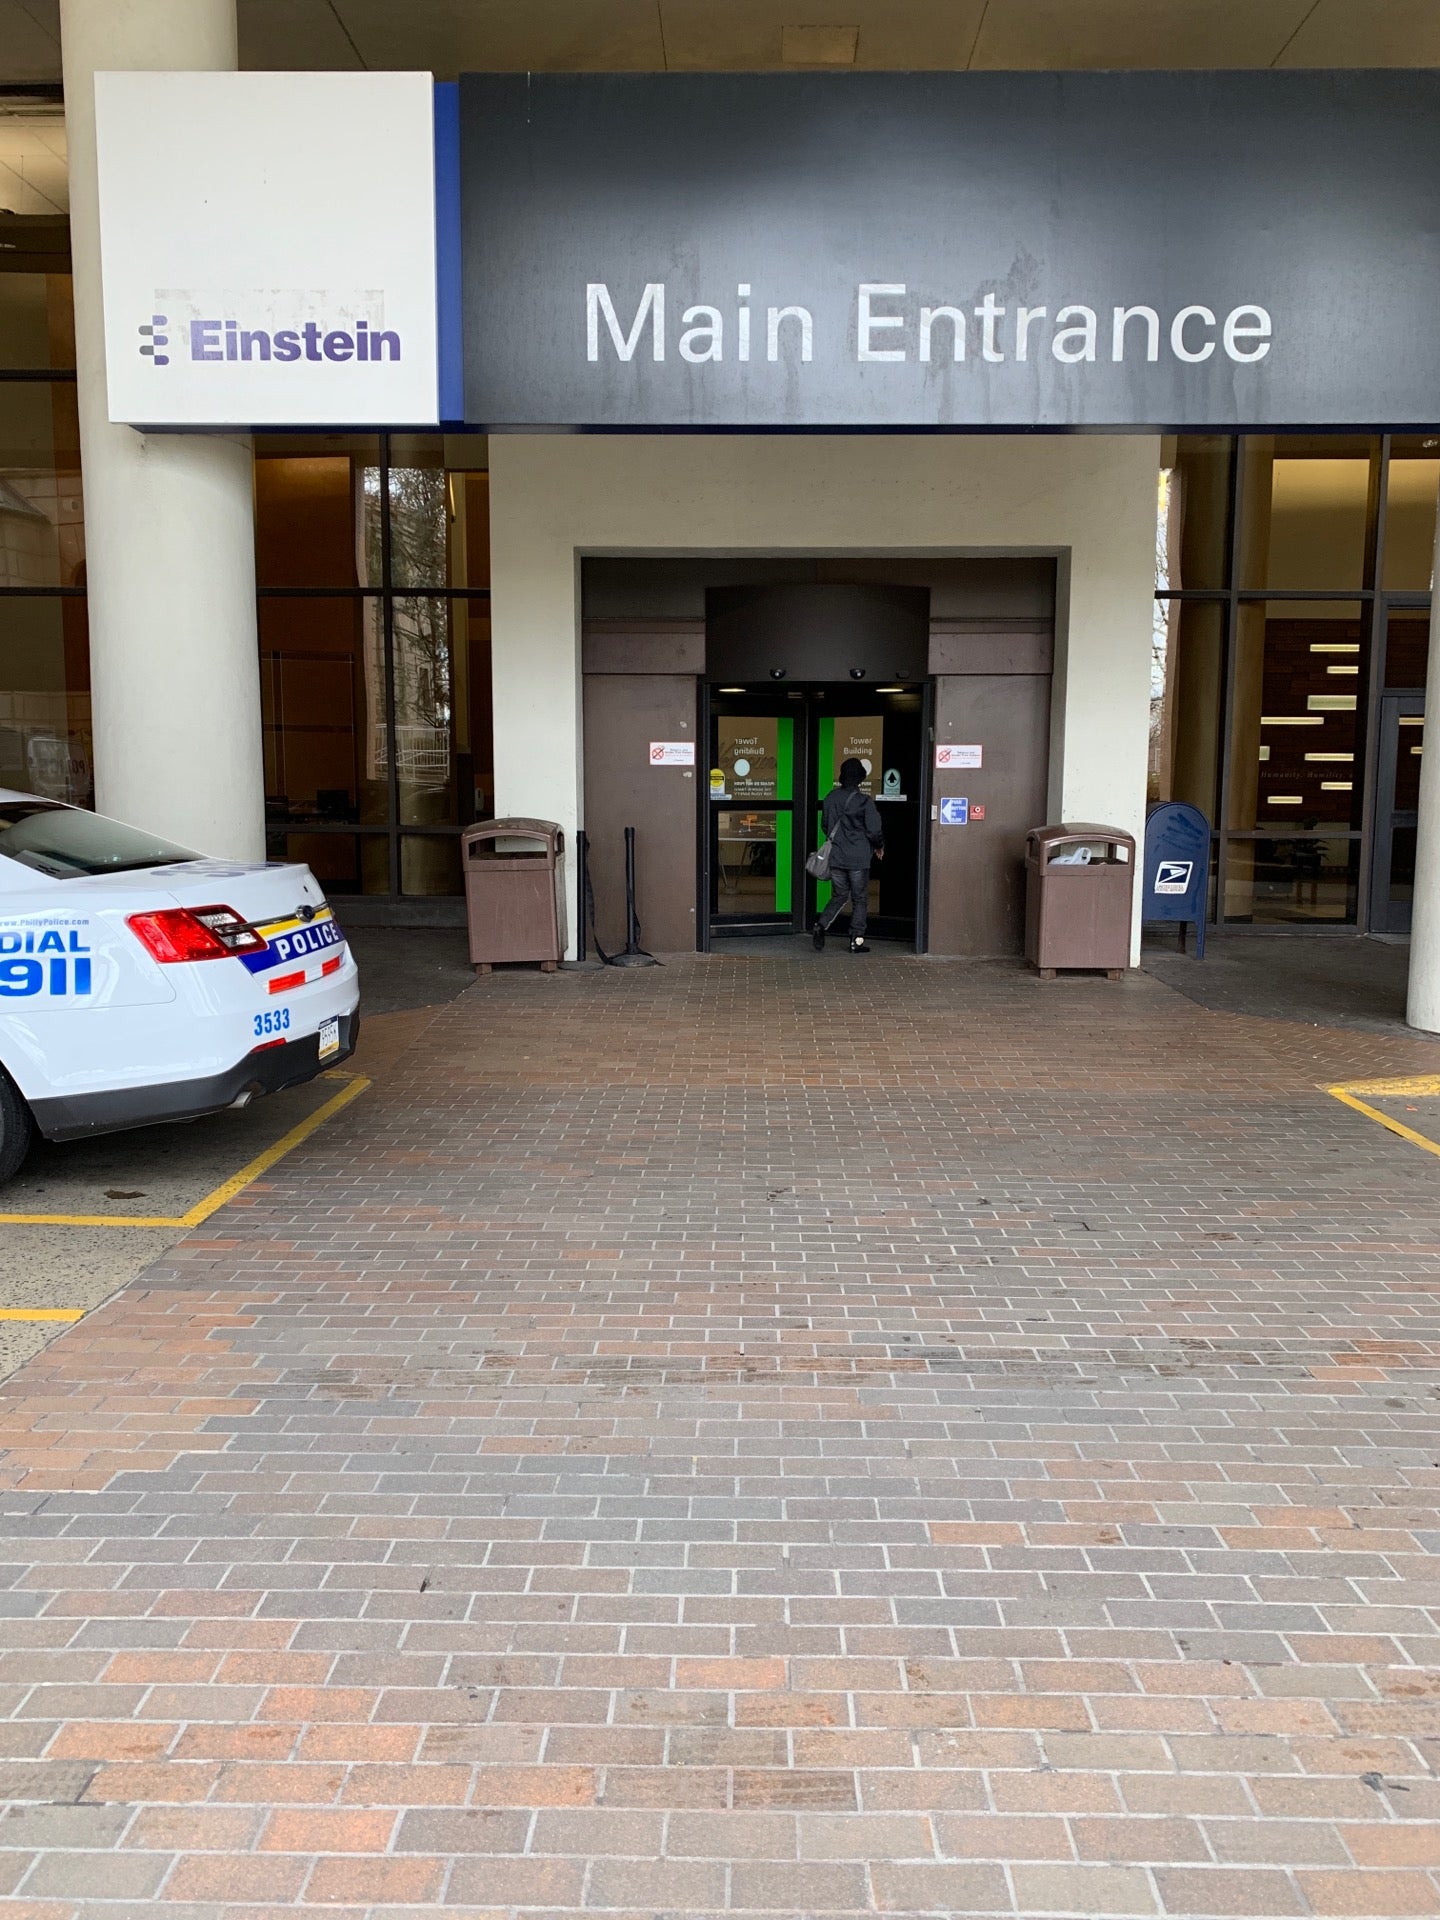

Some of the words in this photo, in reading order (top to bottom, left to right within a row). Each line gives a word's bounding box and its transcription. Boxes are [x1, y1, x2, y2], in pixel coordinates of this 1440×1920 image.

[585, 282, 814, 364] Main
[857, 282, 1273, 364] Entrance
[190, 319, 401, 362] Einstein
[843, 747, 873, 756] Building
[850, 736, 873, 745] Tower
[0, 930, 91, 953] DIAL
[275, 922, 340, 961] POLICE
[0, 958, 91, 997] 911
[253, 1008, 290, 1037] 3533
